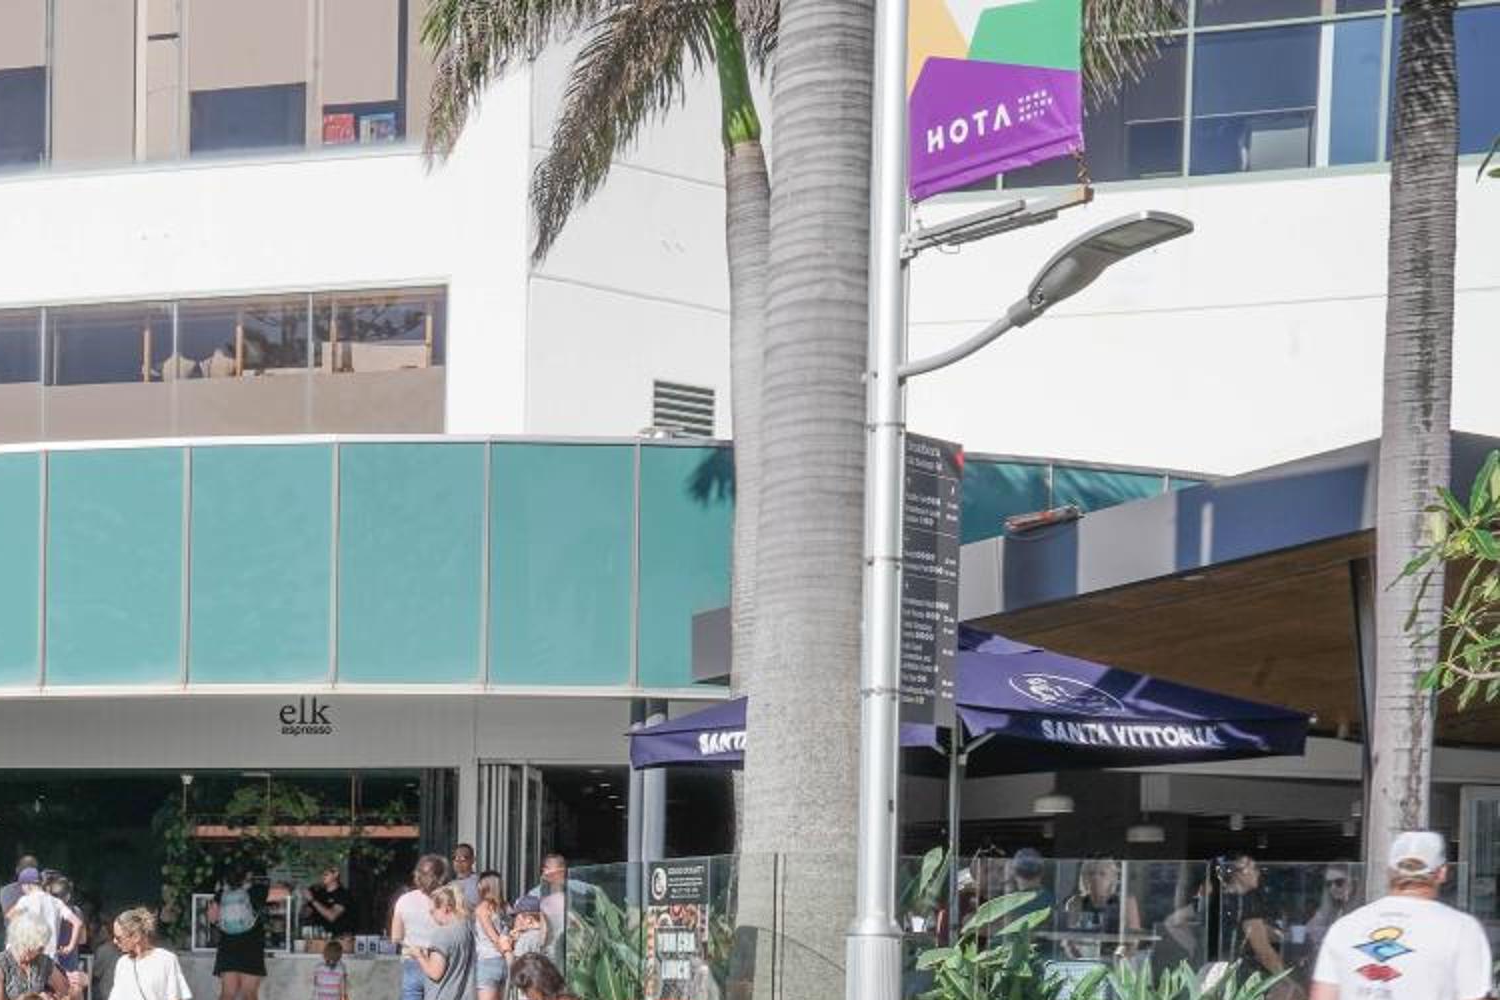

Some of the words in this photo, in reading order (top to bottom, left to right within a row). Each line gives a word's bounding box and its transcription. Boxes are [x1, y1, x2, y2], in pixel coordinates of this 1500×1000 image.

[926, 103, 1012, 153] HOTA
[280, 696, 332, 725] elk
[1041, 719, 1113, 745] SANTA
[1111, 723, 1221, 747] VITTORIA
